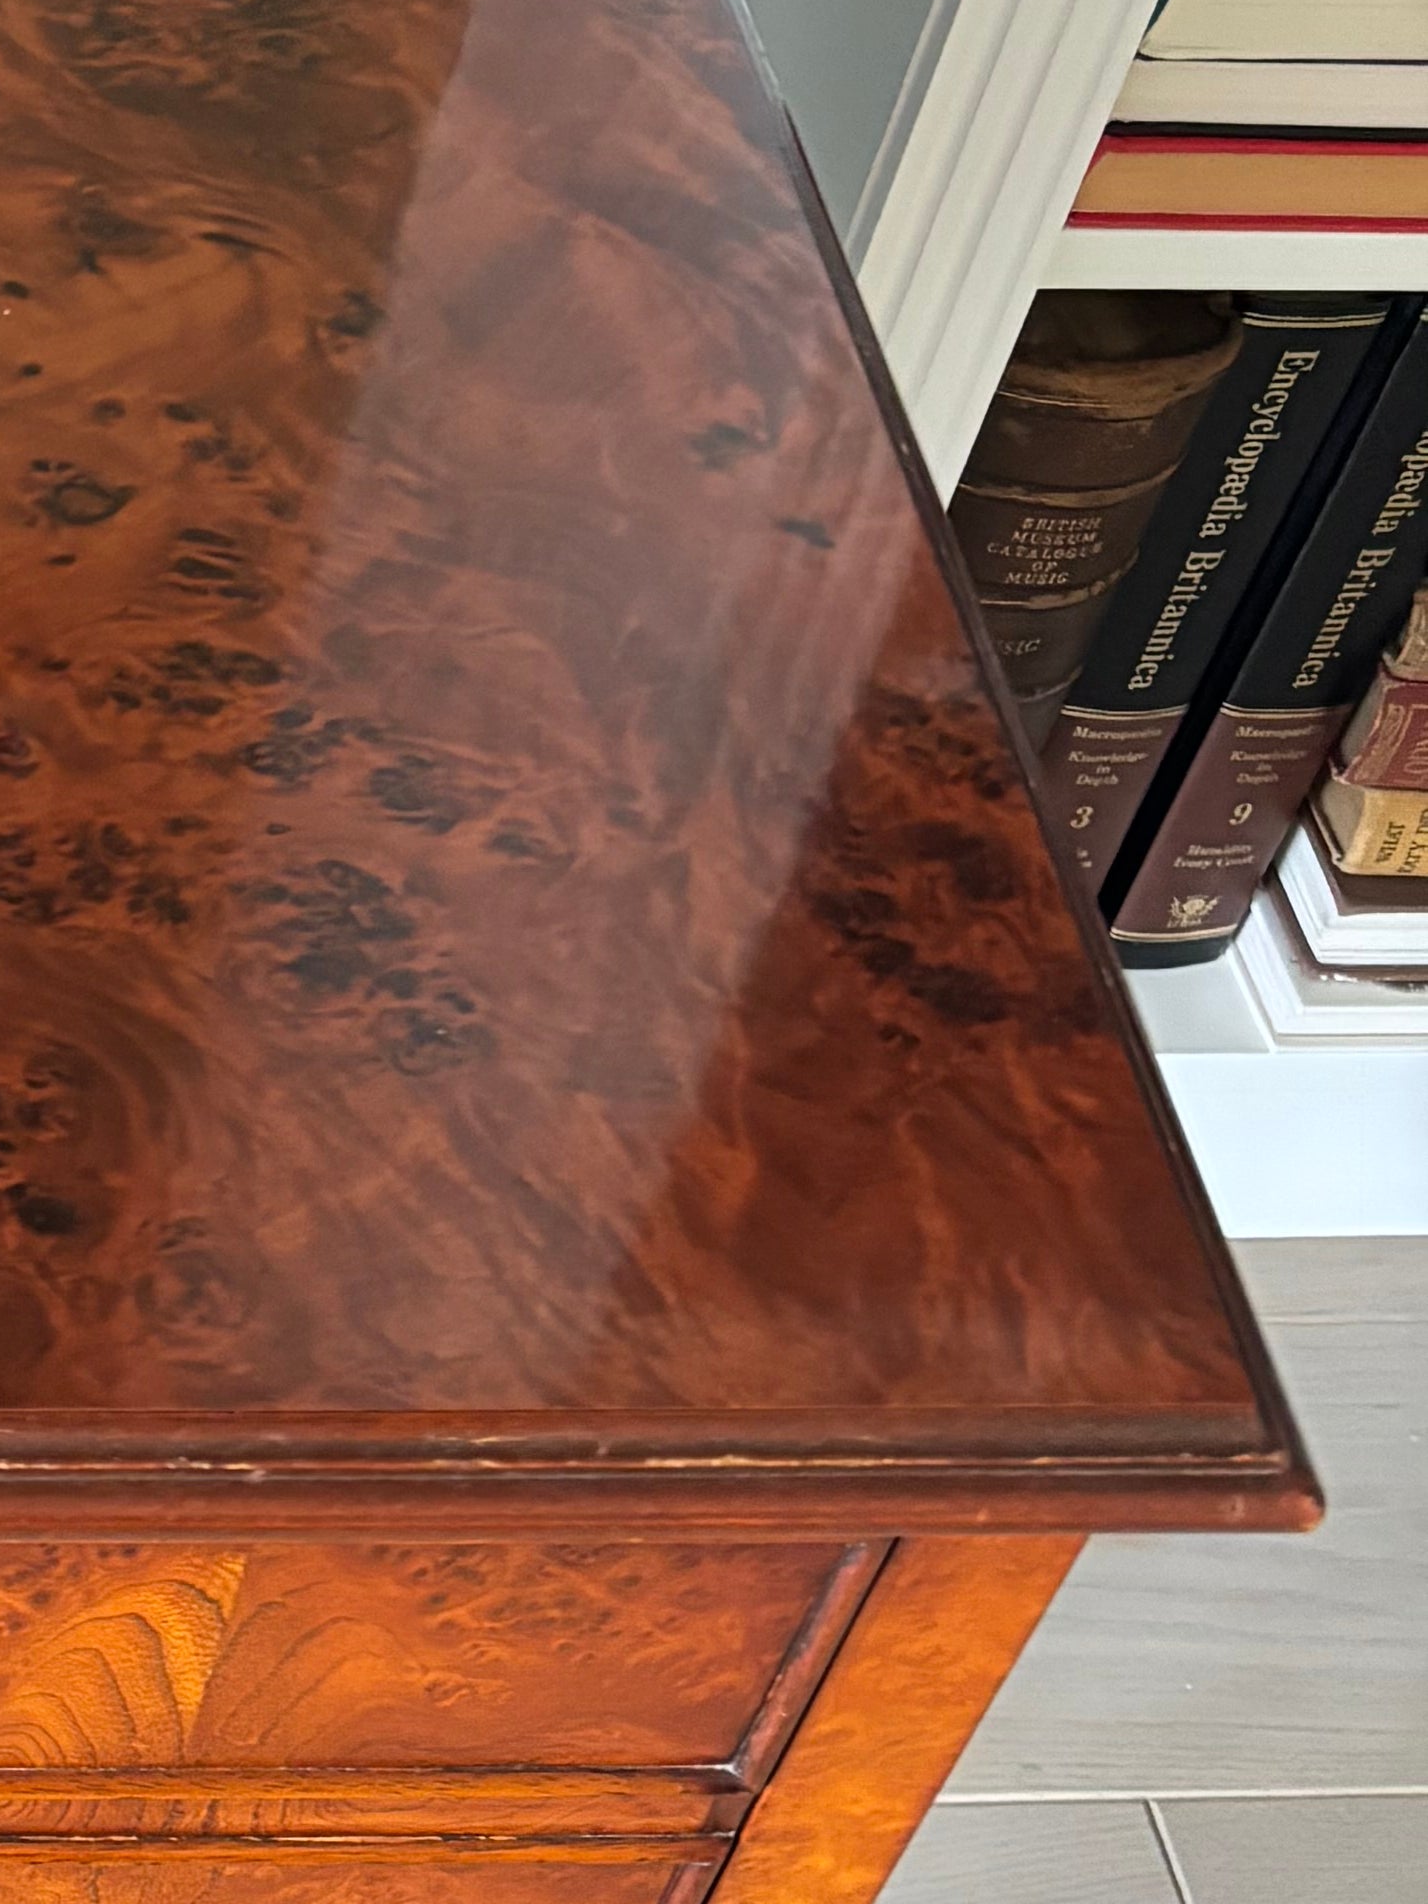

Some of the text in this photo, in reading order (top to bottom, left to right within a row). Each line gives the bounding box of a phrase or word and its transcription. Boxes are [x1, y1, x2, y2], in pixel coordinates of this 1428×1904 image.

[1022, 516, 1102, 531] BRITISH
[1127, 349, 1320, 691] Encyclopædia Britannica
[1011, 530, 1097, 545] MUSEUM
[1032, 561, 1058, 573] OF
[1004, 571, 1069, 585] MUSIC
[1292, 545, 1396, 690] Britannica
[1075, 773, 1120, 787] Depth
[1069, 805, 1094, 829] 3
[1228, 802, 1254, 826] 9
[1374, 821, 1406, 864] WHAT
